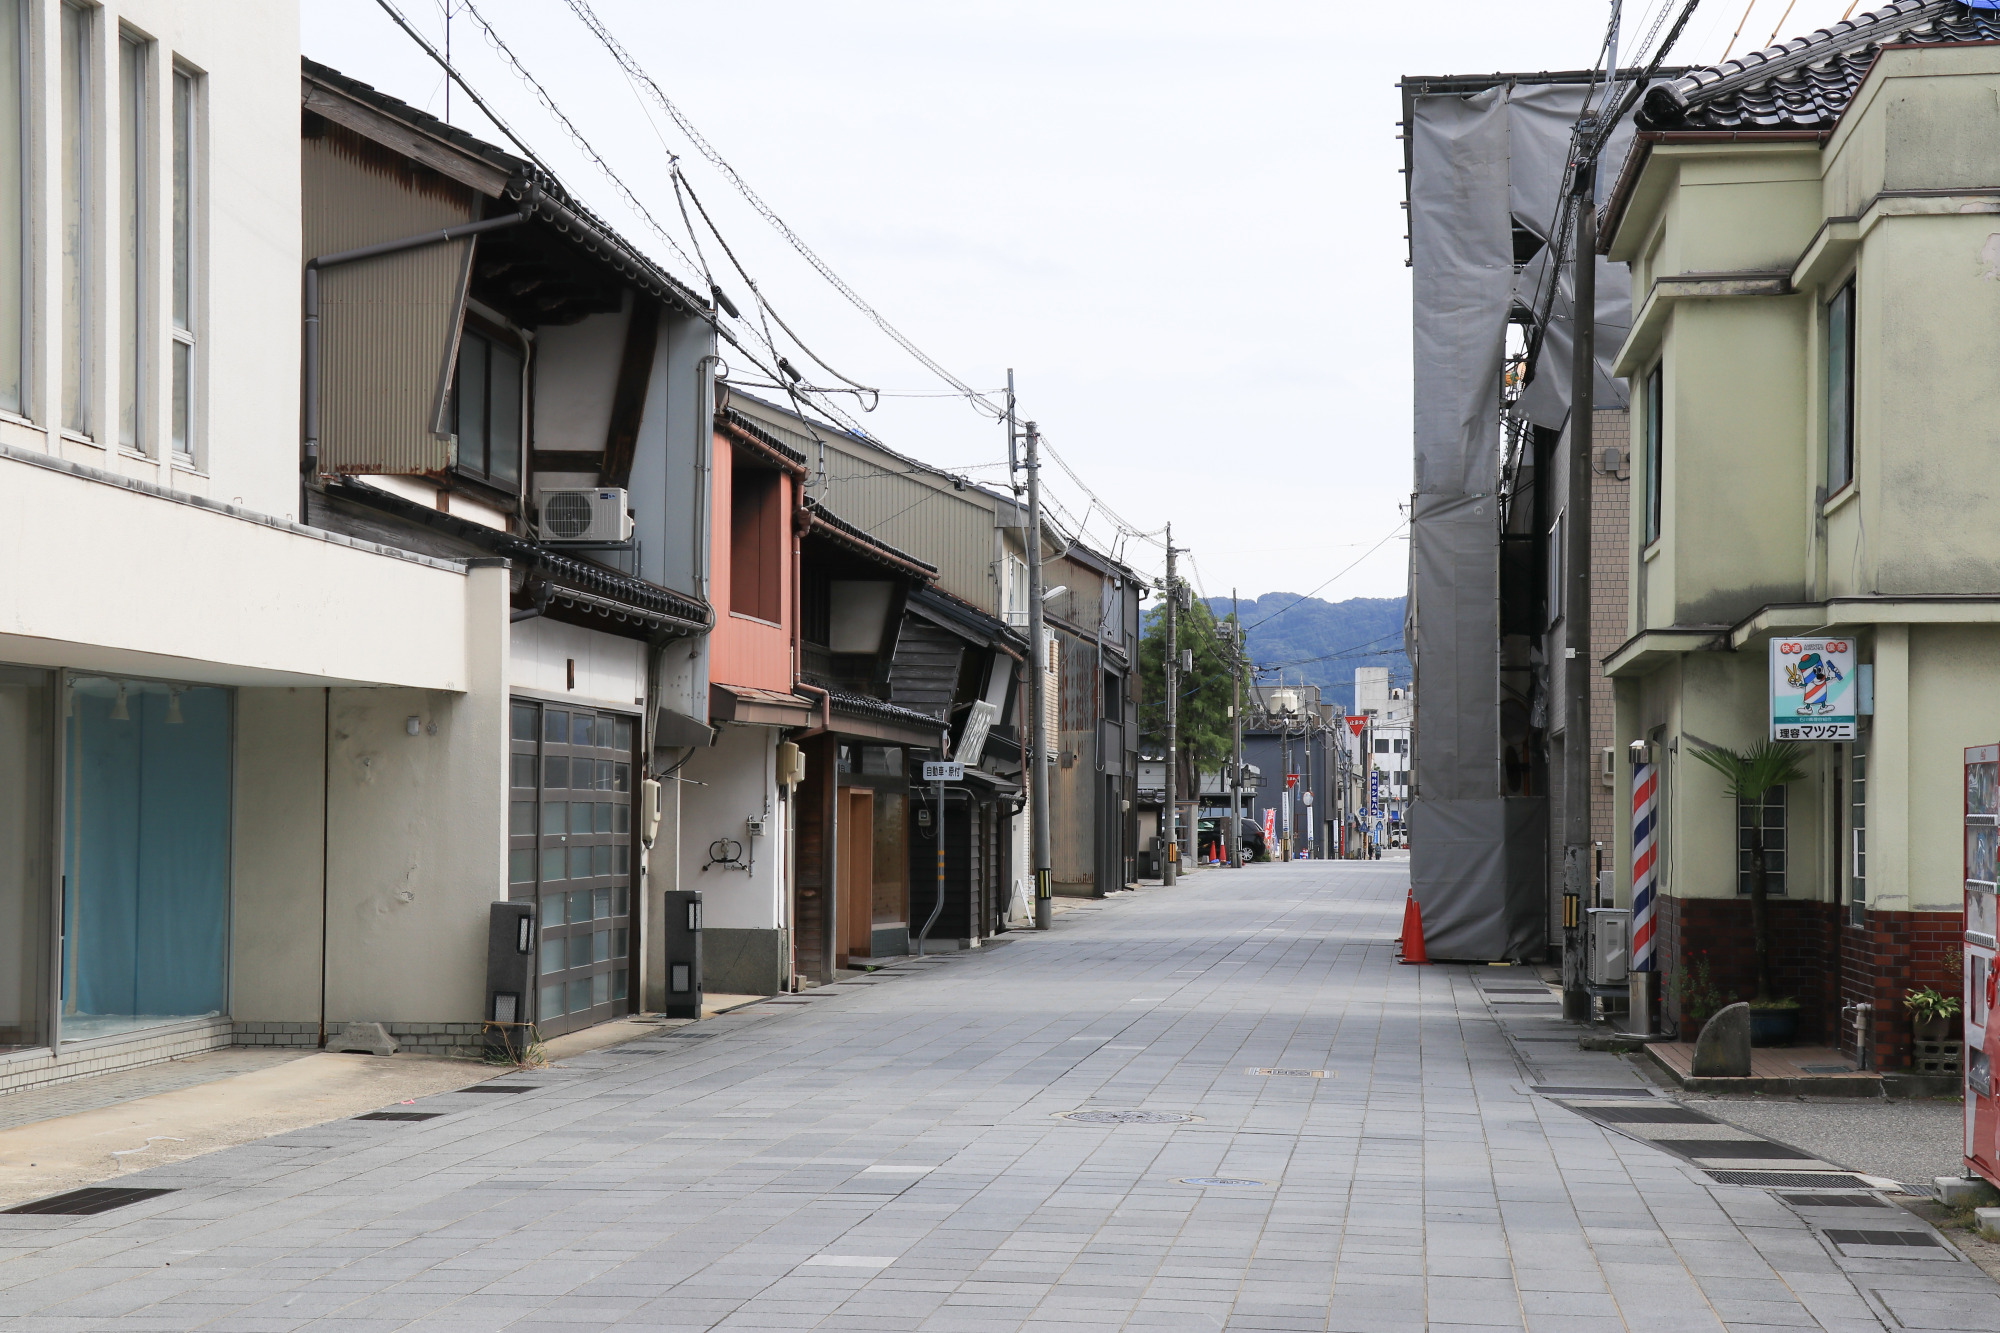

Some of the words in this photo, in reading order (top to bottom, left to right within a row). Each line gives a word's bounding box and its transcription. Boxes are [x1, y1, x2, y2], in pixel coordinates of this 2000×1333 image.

[1779, 725, 1851, 738] 理容マツタニ
[926, 766, 961, 777] 自動車・原付
